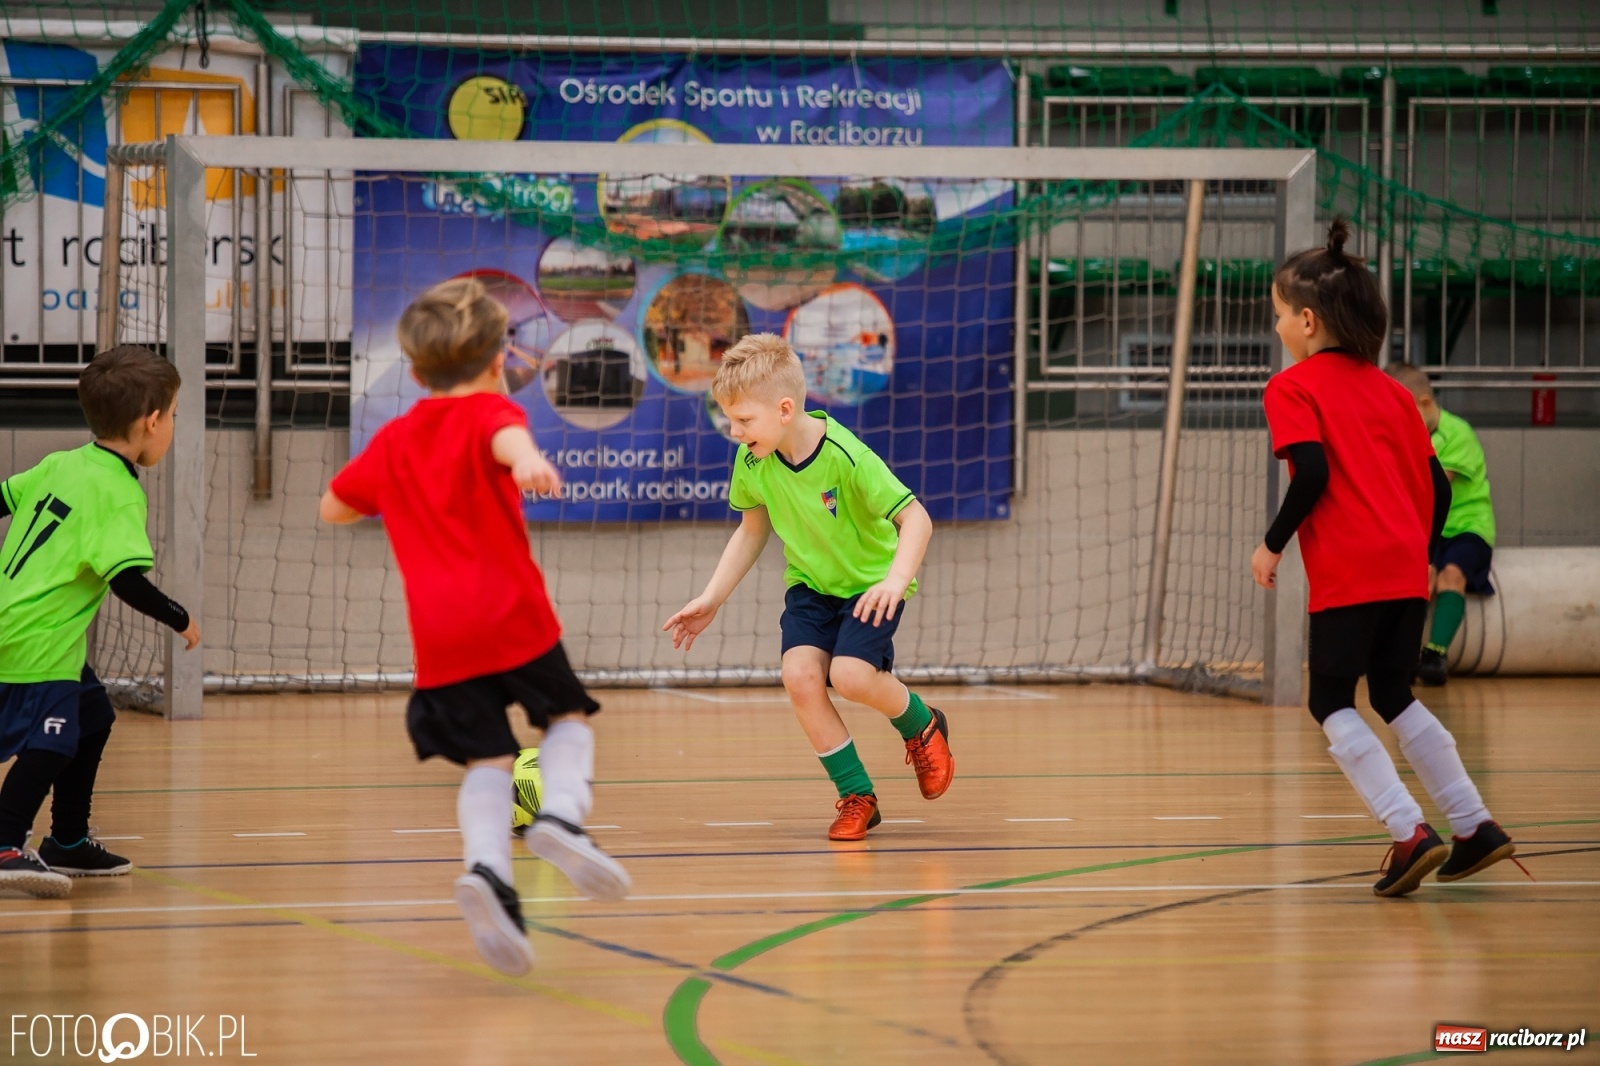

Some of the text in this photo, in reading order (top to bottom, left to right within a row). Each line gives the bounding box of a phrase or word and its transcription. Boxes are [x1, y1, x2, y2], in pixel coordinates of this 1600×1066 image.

[559, 78, 922, 116] Ośrodek Sportu i Rekreacji
[756, 119, 923, 146] w Raciborzu
[3, 492, 73, 581] 17
